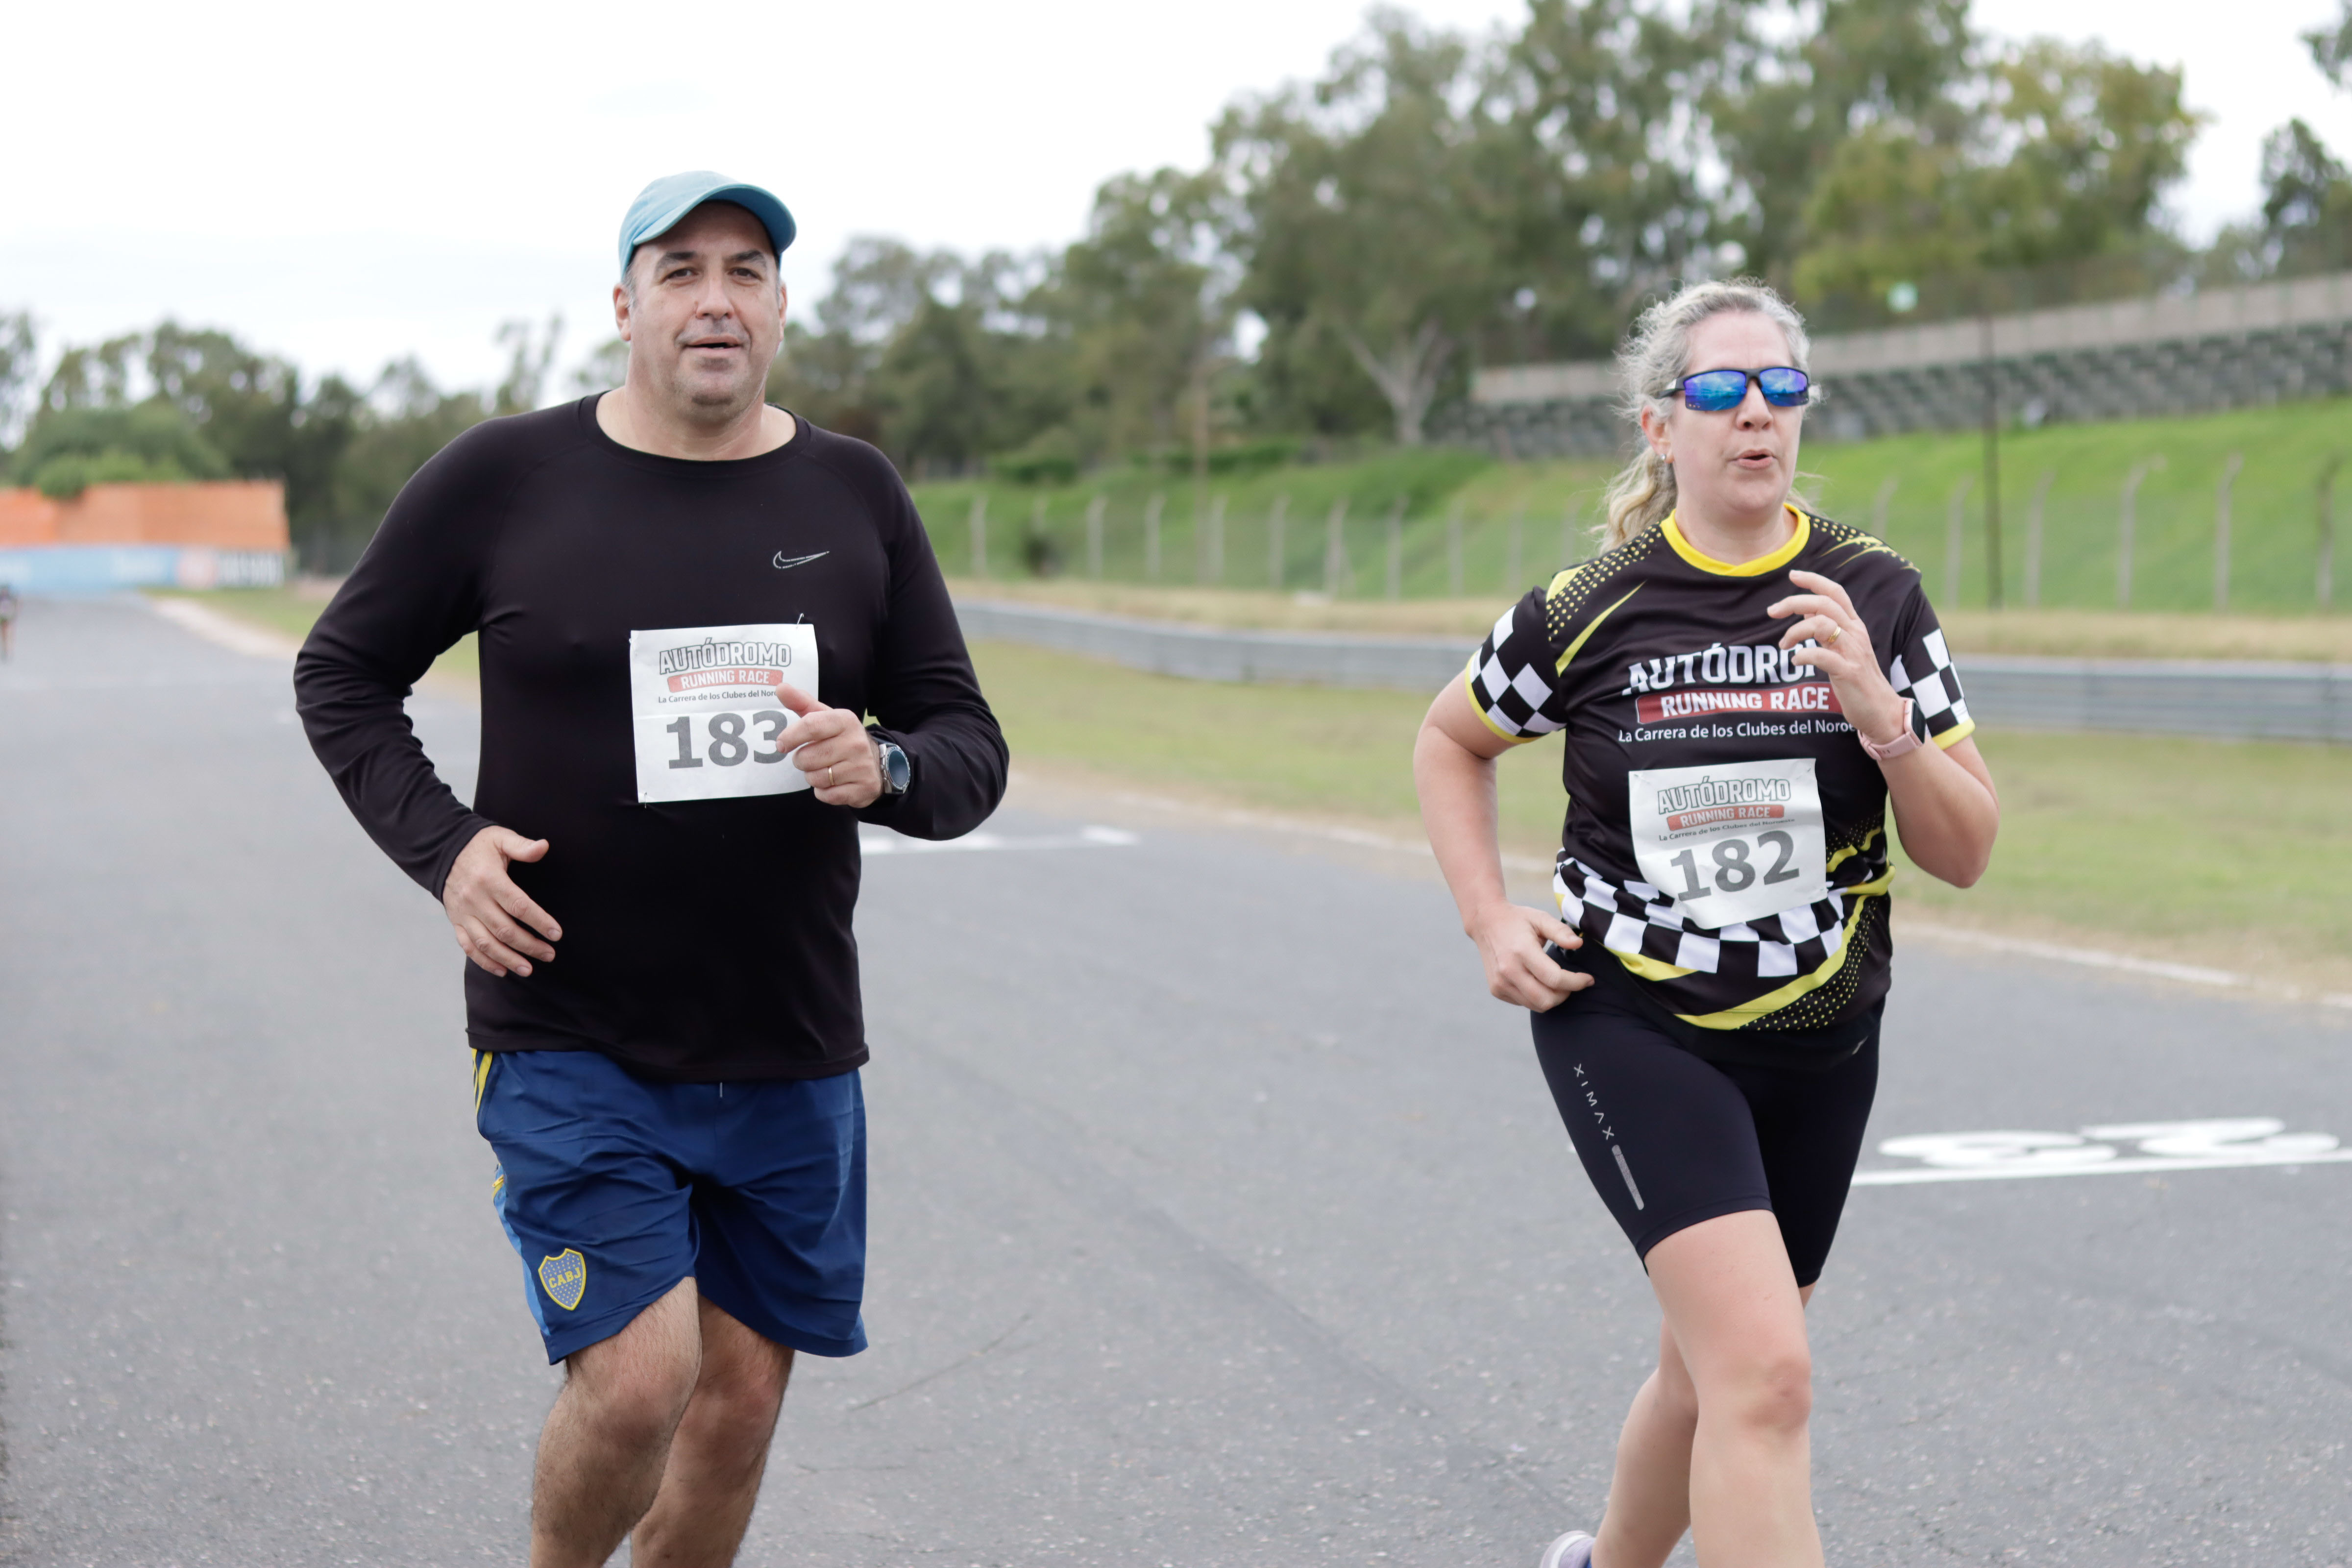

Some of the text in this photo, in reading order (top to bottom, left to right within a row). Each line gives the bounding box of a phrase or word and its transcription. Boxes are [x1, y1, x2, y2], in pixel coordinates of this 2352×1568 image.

[660, 637, 791, 675] AUTÓDROMO
[1622, 638, 1817, 695] AUTÓDRO
[680, 670, 770, 689] RUNNING RACE
[1661, 686, 1830, 717] RUNNING RACE
[666, 710, 788, 769] 183
[1618, 719, 1858, 742] La Carrera de los Clubes del Noroe
[1658, 776, 1791, 815] AUTÓDROMO
[1680, 807, 1771, 828] RUNNING RACE
[1669, 831, 1697, 839] Carrera
[1670, 830, 1800, 902] 182
[1573, 1063, 1615, 1140] XIMAX
[548, 1267, 581, 1289] CABJ
